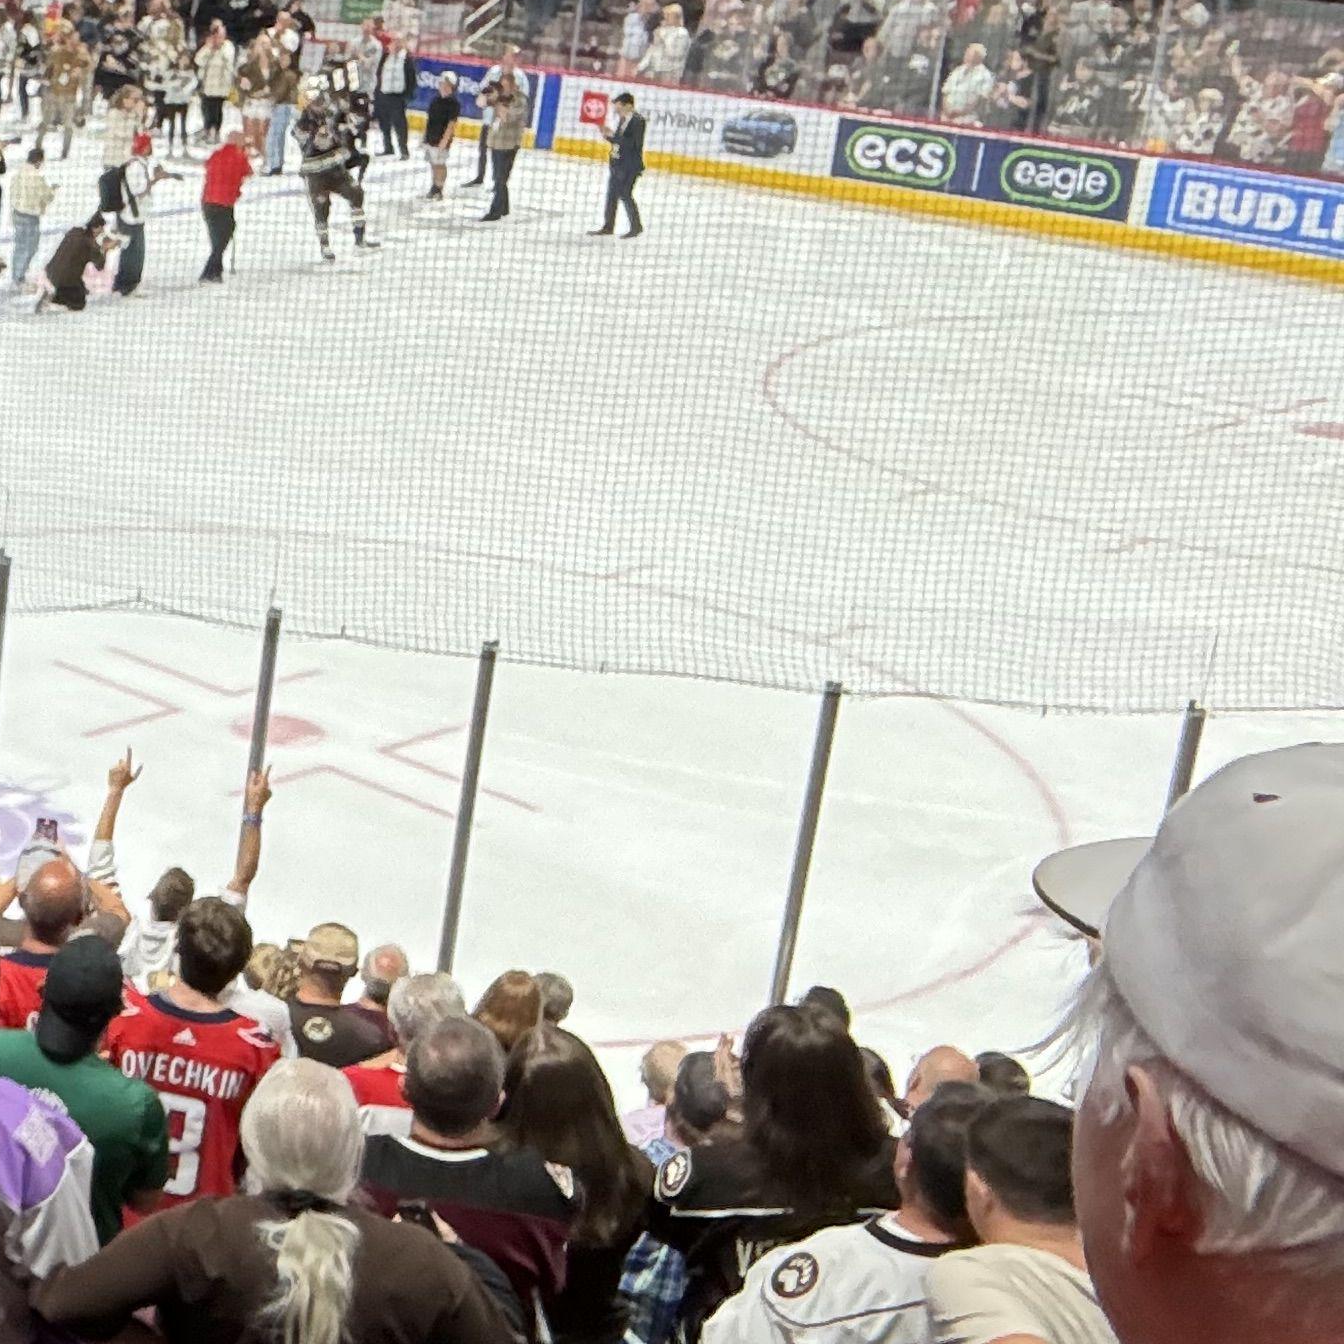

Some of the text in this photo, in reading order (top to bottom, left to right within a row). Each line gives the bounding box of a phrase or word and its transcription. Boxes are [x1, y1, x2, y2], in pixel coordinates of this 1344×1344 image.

[853, 134, 946, 178] ecs
[1013, 158, 1108, 201] eagle
[1180, 180, 1297, 233] BUD
[121, 1049, 246, 1100] OVECHKIN
